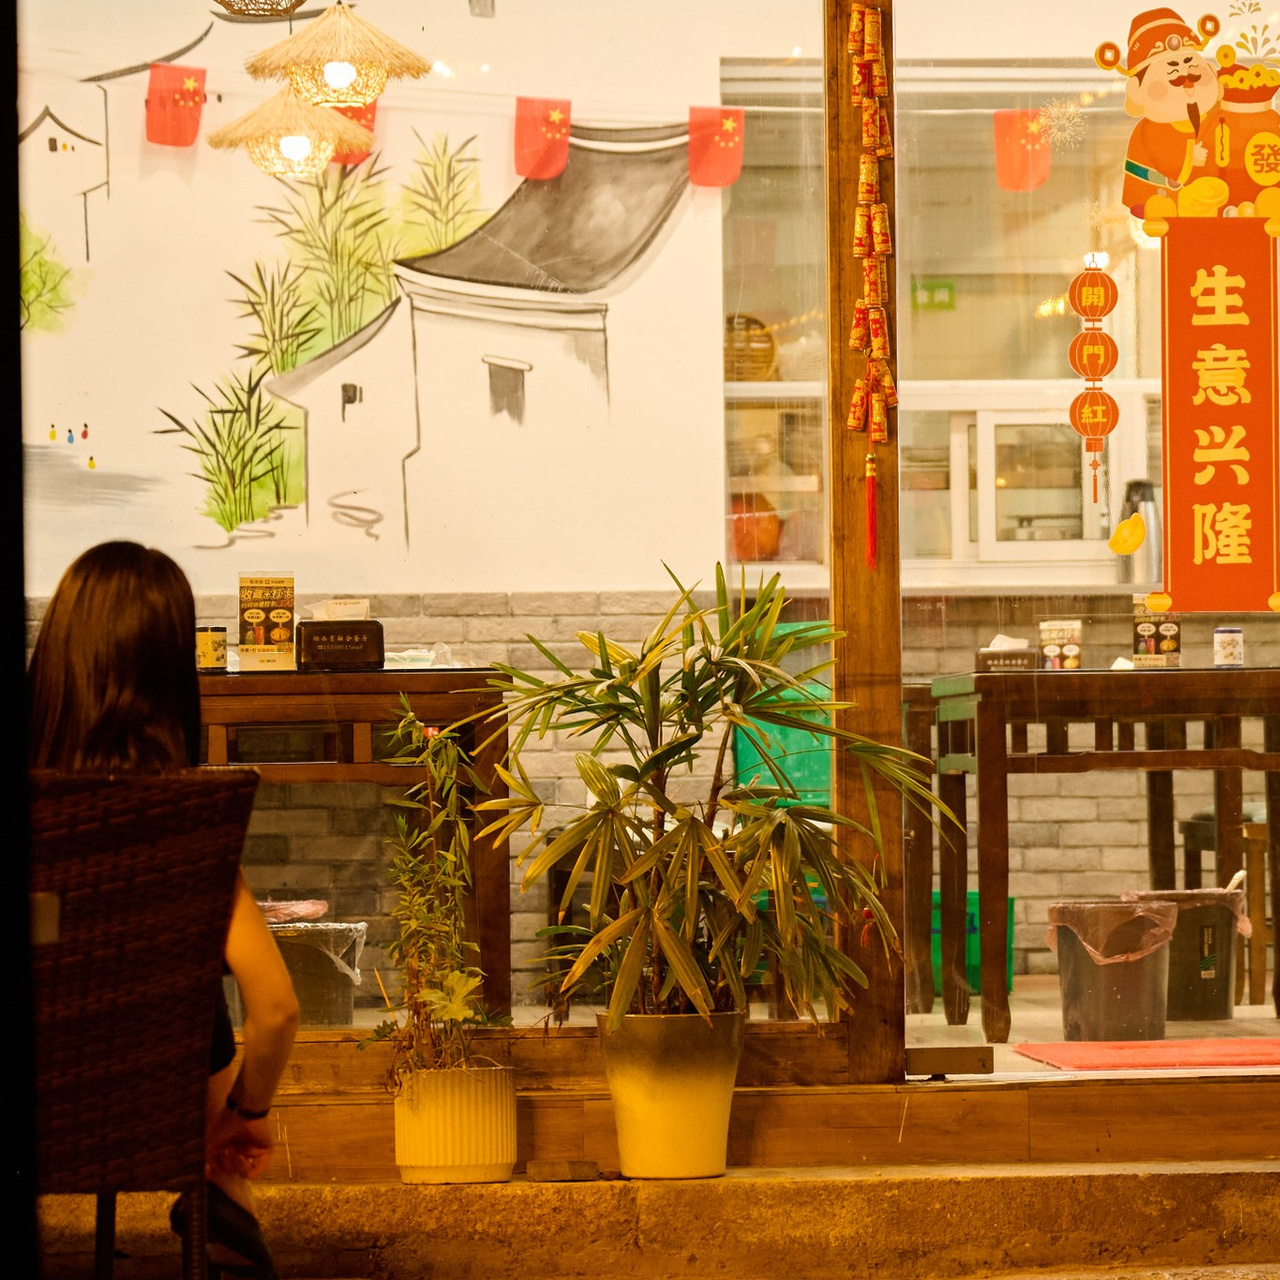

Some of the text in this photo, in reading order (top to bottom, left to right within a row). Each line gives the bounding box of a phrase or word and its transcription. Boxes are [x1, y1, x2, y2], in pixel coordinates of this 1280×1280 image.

[1252, 143, 1280, 174] 發
[1081, 286, 1108, 424] 開門紅
[1190, 264, 1253, 567] 生意兴隆
